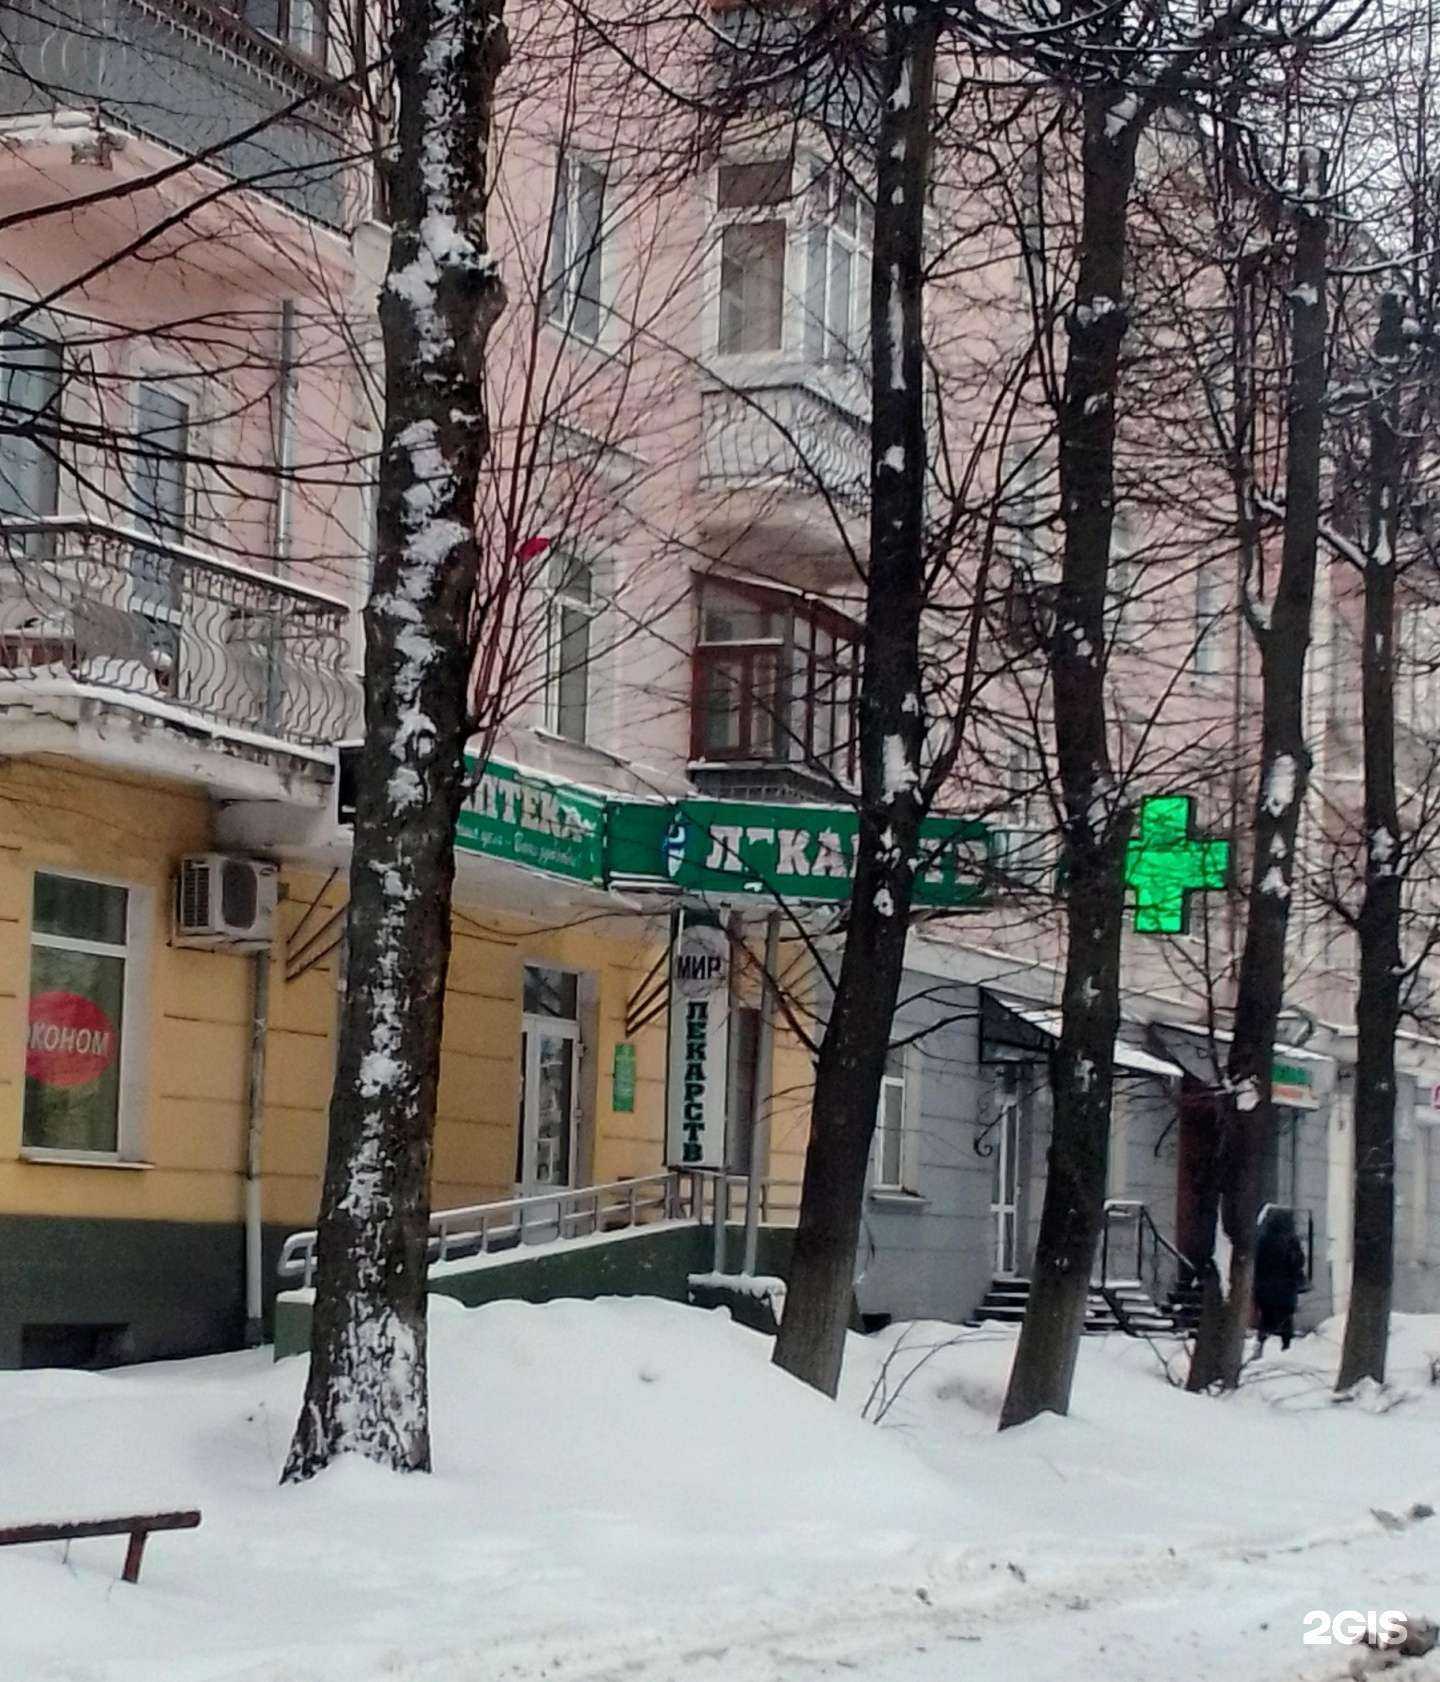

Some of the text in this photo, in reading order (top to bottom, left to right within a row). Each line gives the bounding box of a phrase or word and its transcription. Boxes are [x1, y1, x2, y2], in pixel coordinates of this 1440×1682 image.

[461, 773, 597, 843] ПТЕКА
[677, 955, 721, 980] МИР
[682, 1001, 709, 1162] ЛЕКАРСТВ
